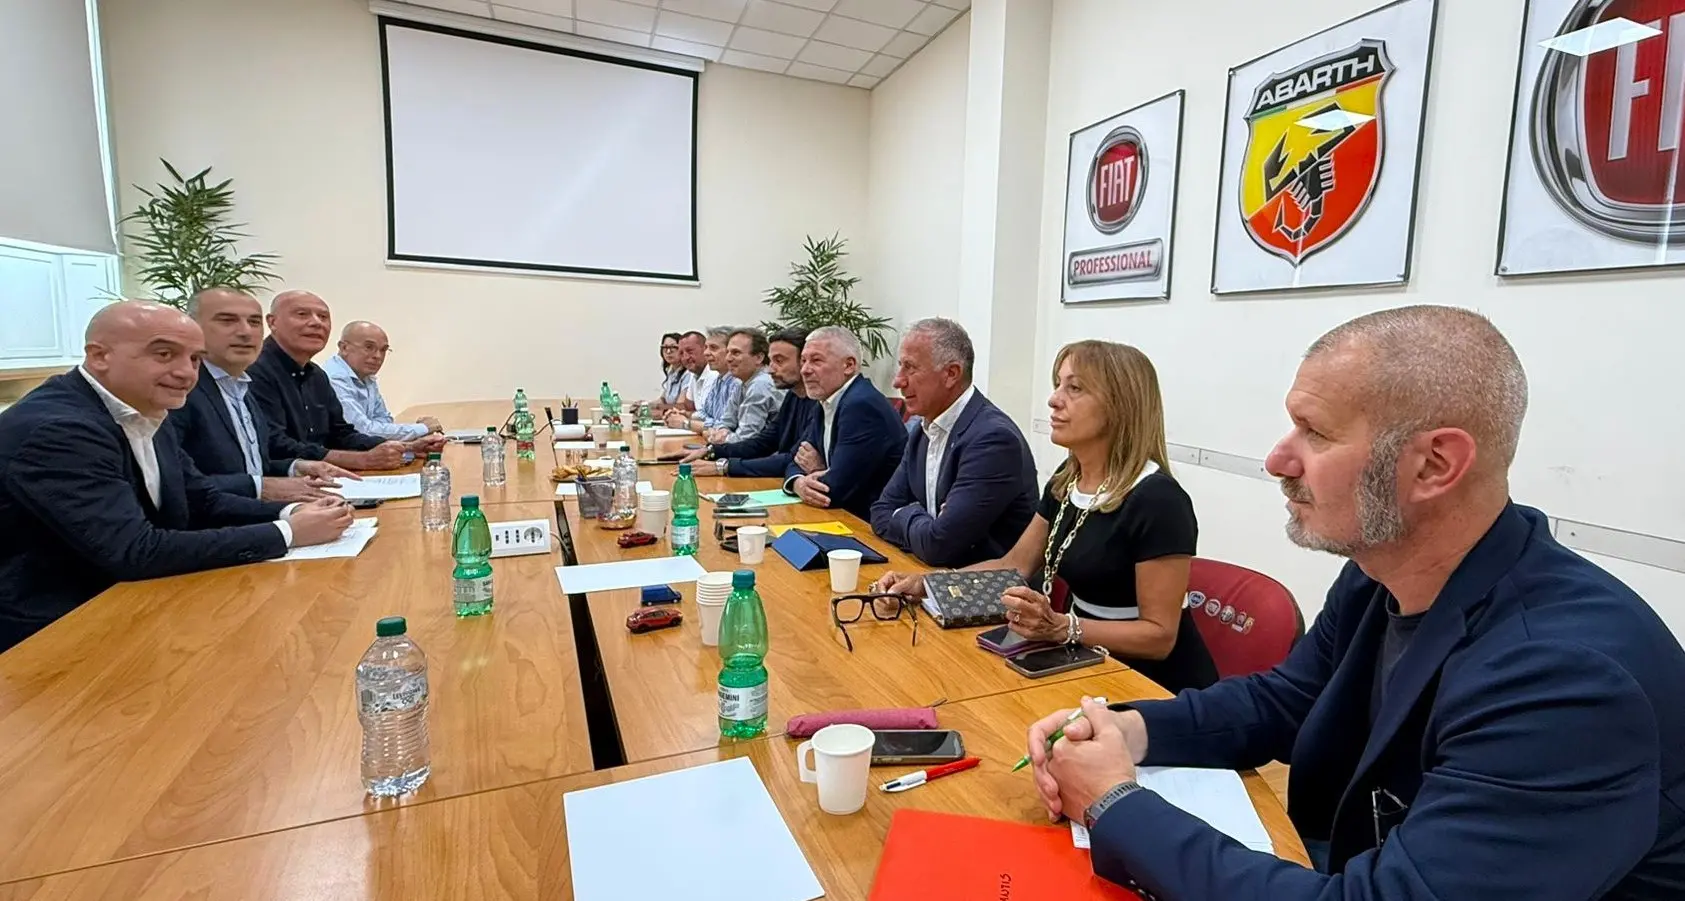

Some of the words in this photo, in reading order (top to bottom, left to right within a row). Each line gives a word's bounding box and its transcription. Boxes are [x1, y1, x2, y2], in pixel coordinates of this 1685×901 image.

[1256, 55, 1375, 110] ABARTH
[1099, 155, 1134, 209] FIAT
[1073, 251, 1153, 276] PROFESSIONAL
